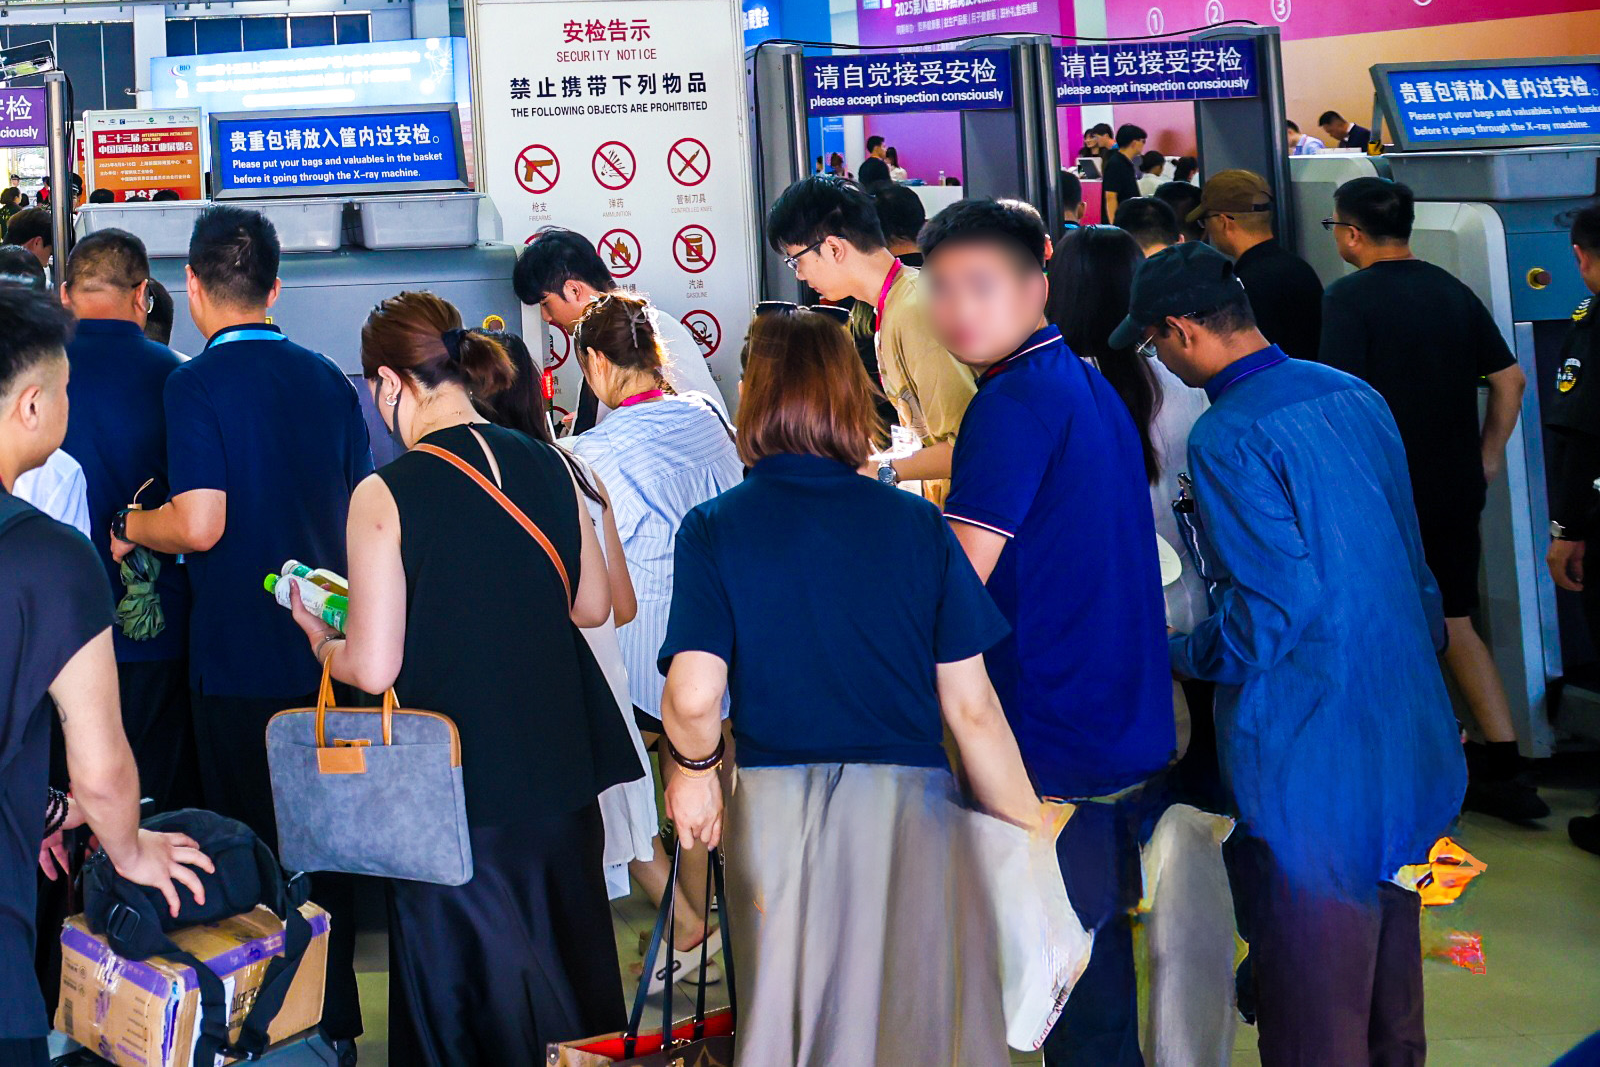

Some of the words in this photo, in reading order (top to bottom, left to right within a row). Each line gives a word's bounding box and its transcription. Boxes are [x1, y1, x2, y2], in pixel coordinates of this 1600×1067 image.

[562, 18, 651, 44] 安检告示
[556, 50, 610, 62] SECURITY
[617, 49, 657, 61] NOTICE
[1060, 47, 1242, 79] 请自觉接受安检
[814, 58, 997, 90] 请自觉接受安检
[510, 72, 707, 100] 禁止携带下列物品
[1056, 83, 1091, 98] please
[1093, 81, 1129, 96] accept
[1130, 80, 1185, 94] inspection
[1187, 77, 1249, 91] consciously
[810, 95, 845, 109] please
[847, 93, 882, 107] accept
[884, 91, 940, 106] inspection
[941, 88, 1004, 102] consciously
[511, 108, 529, 117] THE
[531, 105, 585, 117] FOLLOWING
[587, 104, 628, 115] OBJECTS
[630, 103, 648, 113] ARE
[650, 101, 708, 112] PROHITBITED
[1408, 111, 1436, 121] Please
[1438, 111, 1452, 121] put
[1453, 111, 1473, 120] your
[1474, 109, 1495, 119] bags
[1496, 108, 1511, 117] and
[1513, 107, 1552, 116] valuables
[1553, 106, 1561, 114] in
[1563, 105, 1577, 114] the
[1414, 126, 1442, 136] before
[1443, 126, 1450, 135] it
[1451, 125, 1475, 136] going
[1477, 123, 1510, 134] through
[1511, 122, 1525, 131] the
[230, 123, 440, 153] 贵重包请放入筐内过安检。
[232, 159, 261, 169] Please
[263, 160, 278, 170] put
[280, 159, 300, 168] your
[302, 157, 323, 167] bags
[325, 156, 341, 166] and
[343, 155, 384, 165] valuables
[386, 154, 395, 163] in
[397, 153, 411, 163] the
[413, 152, 443, 161] basket
[233, 173, 262, 184] before
[263, 173, 270, 183] it
[272, 173, 298, 184] going
[299, 171, 335, 182] through
[337, 170, 351, 180] the
[353, 170, 379, 180] X-ray
[381, 169, 420, 178] machine.
[532, 202, 548, 213] 枪支
[608, 198, 624, 209] 弹药
[676, 193, 707, 205] 管制刀具
